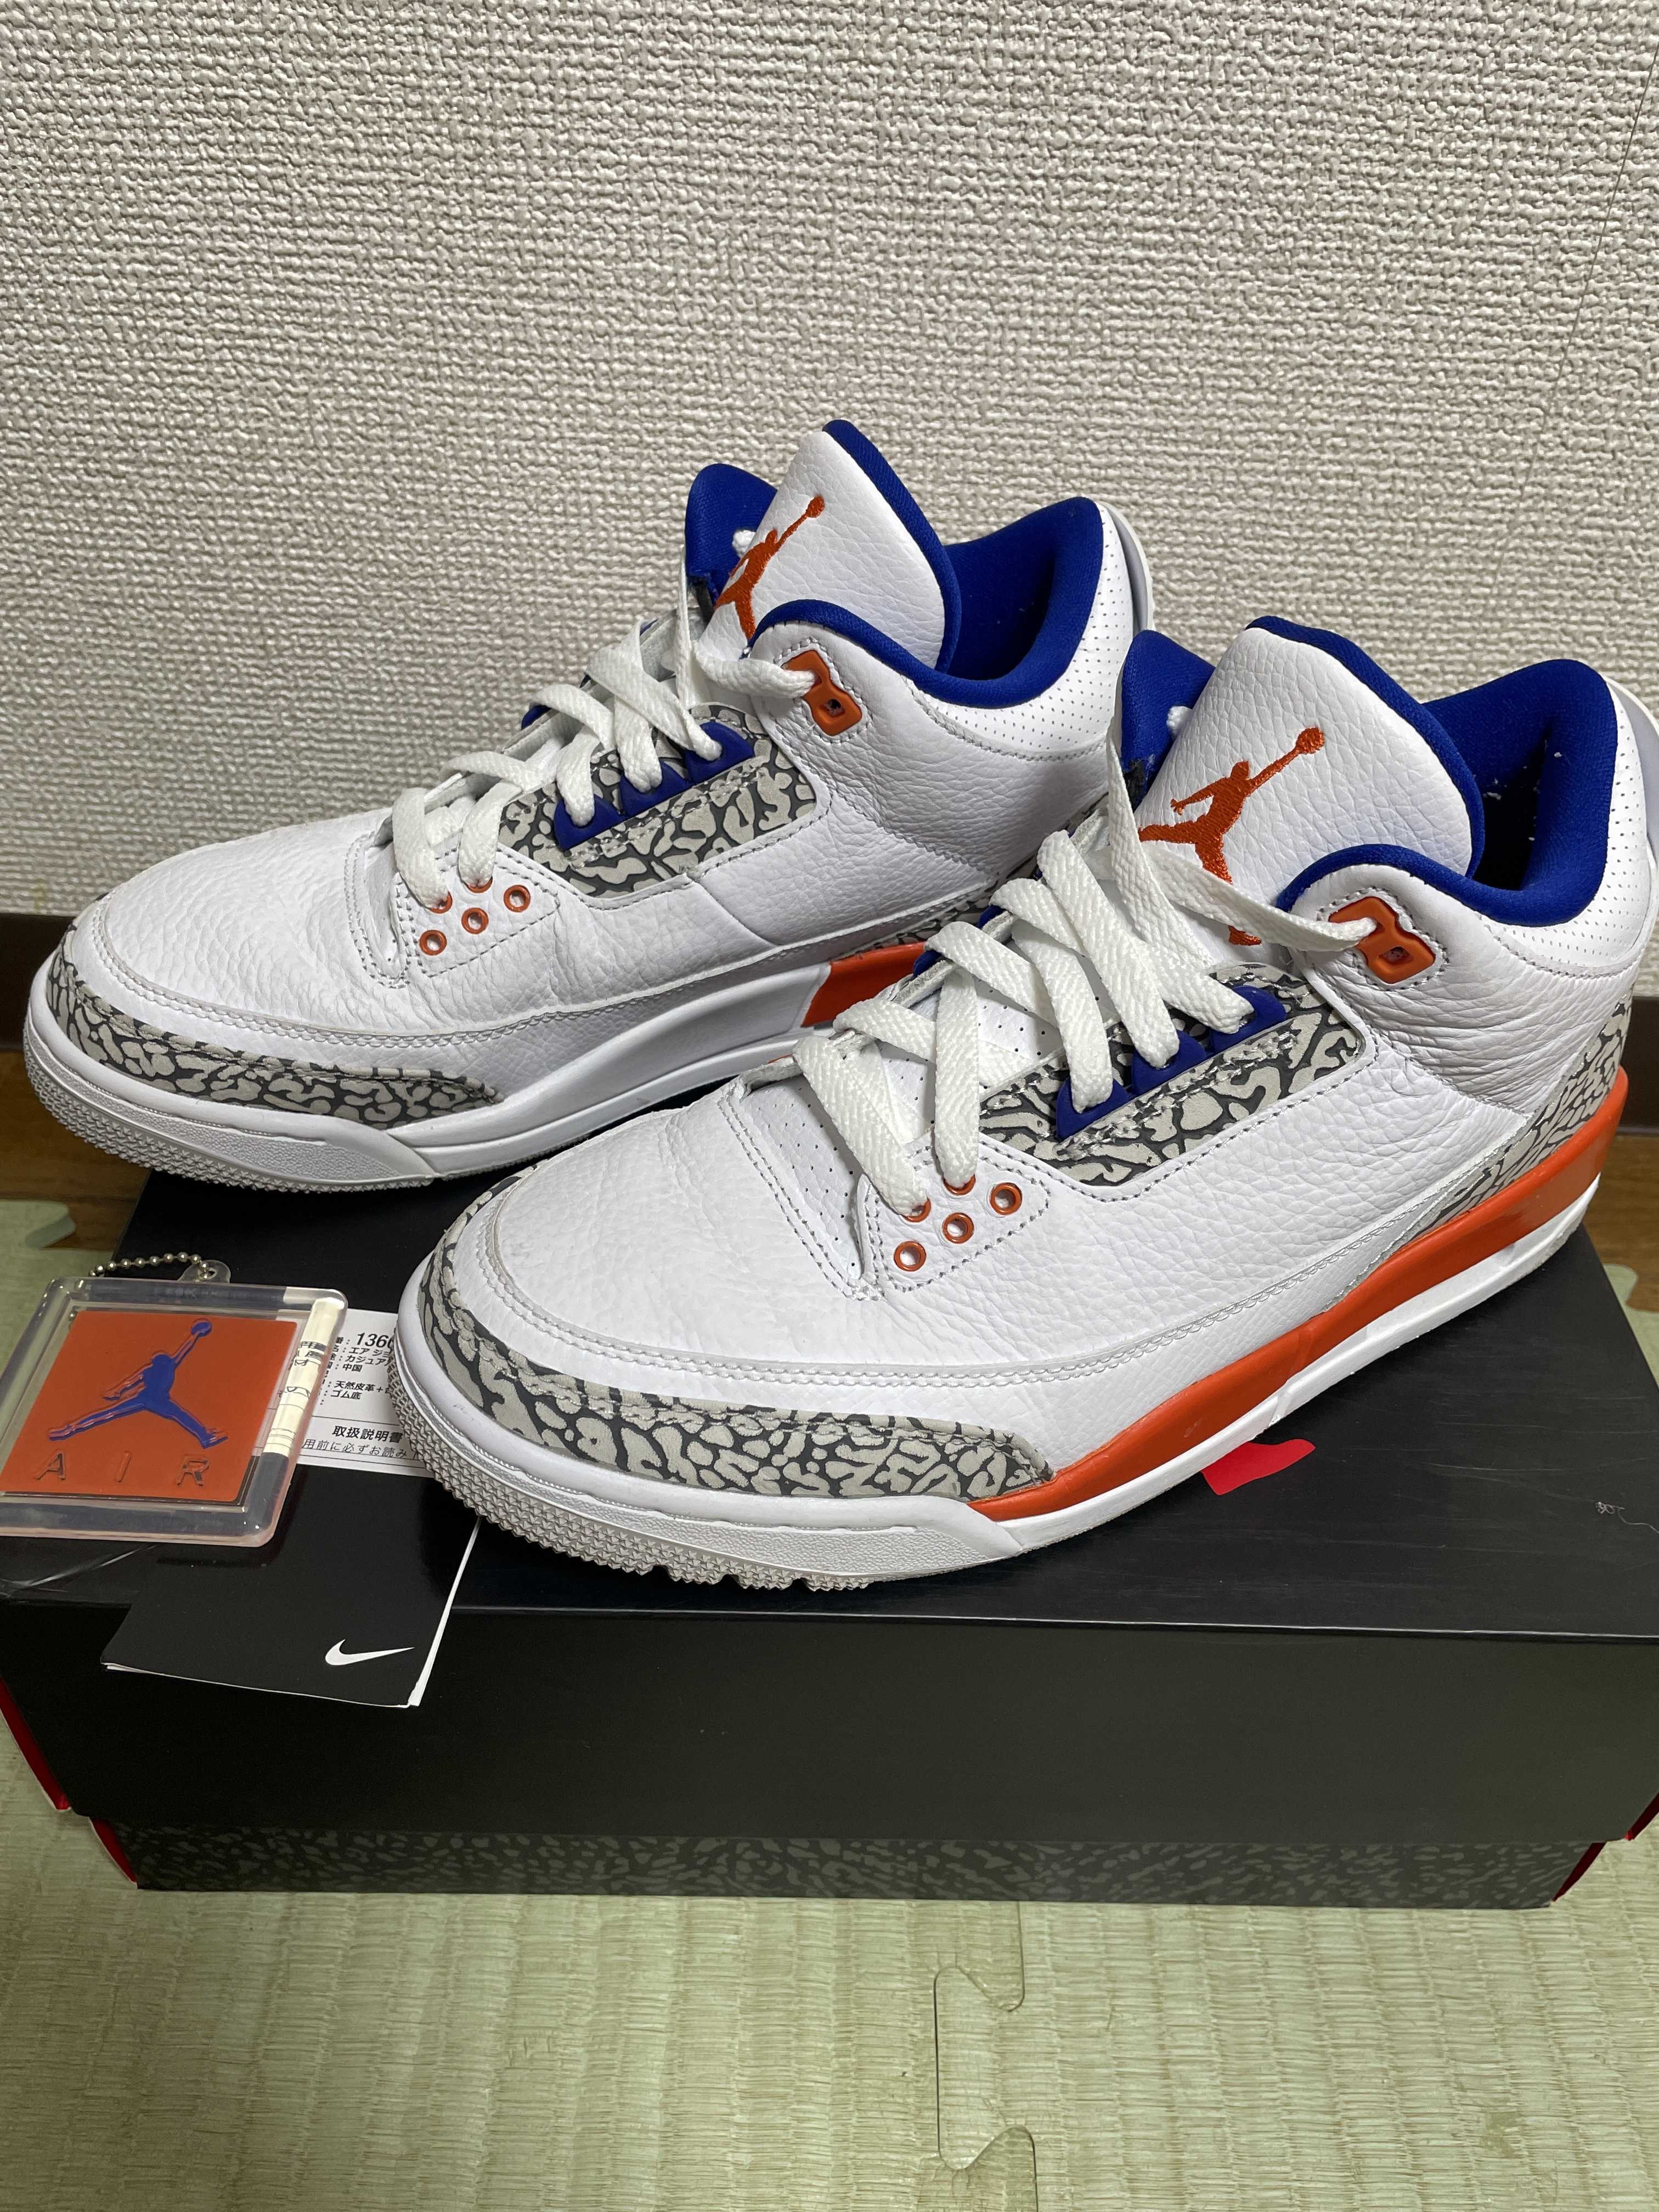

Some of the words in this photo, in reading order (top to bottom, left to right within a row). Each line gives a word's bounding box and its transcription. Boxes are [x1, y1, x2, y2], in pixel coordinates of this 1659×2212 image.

[342, 1363, 363, 1373] 中国
[330, 1390, 363, 1400] ゴム底
[331, 1425, 404, 1443] 取扱説明書
